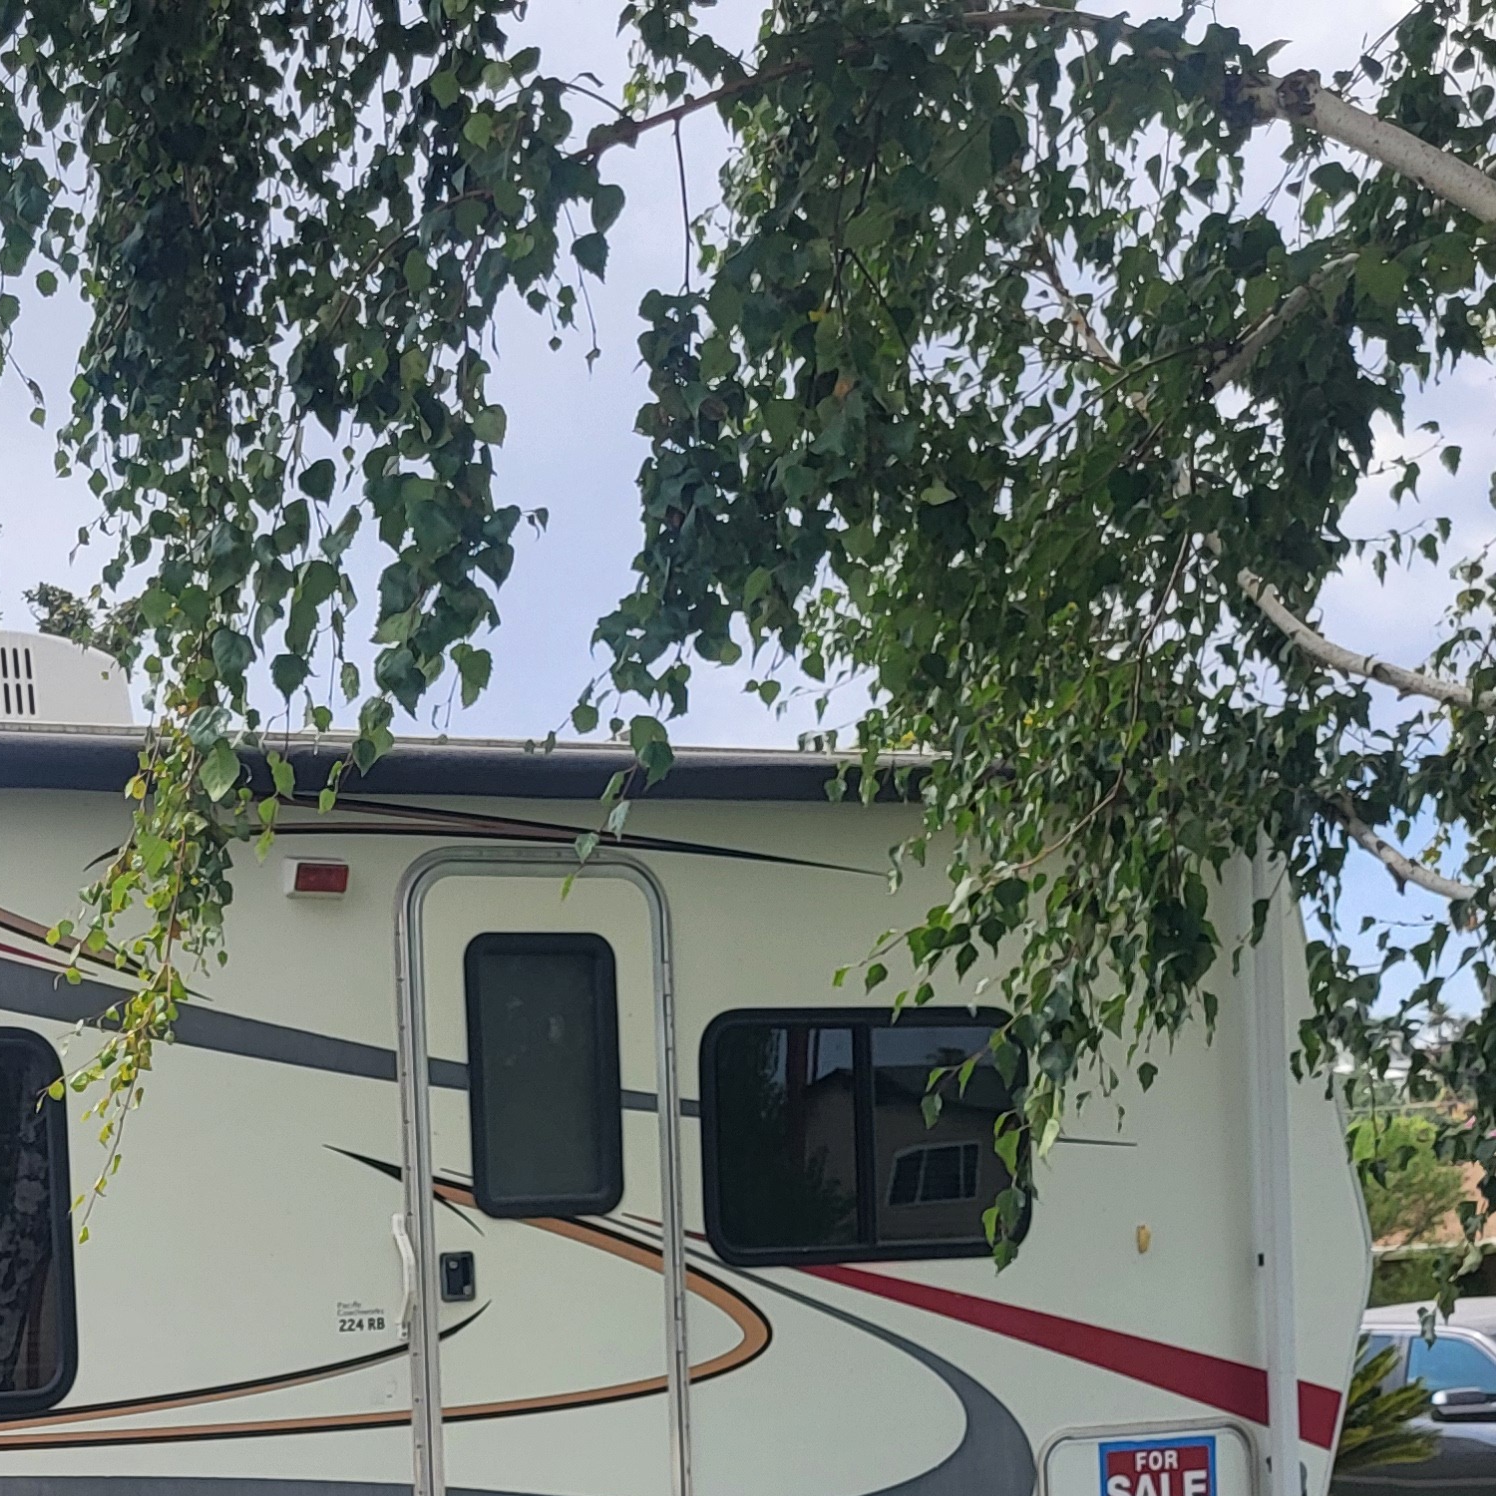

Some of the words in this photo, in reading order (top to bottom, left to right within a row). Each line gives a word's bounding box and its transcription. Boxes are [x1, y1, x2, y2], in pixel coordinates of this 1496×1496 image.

[339, 1318, 364, 1332] 224
[367, 1317, 385, 1331] RB
[1135, 1450, 1178, 1472] FOR
